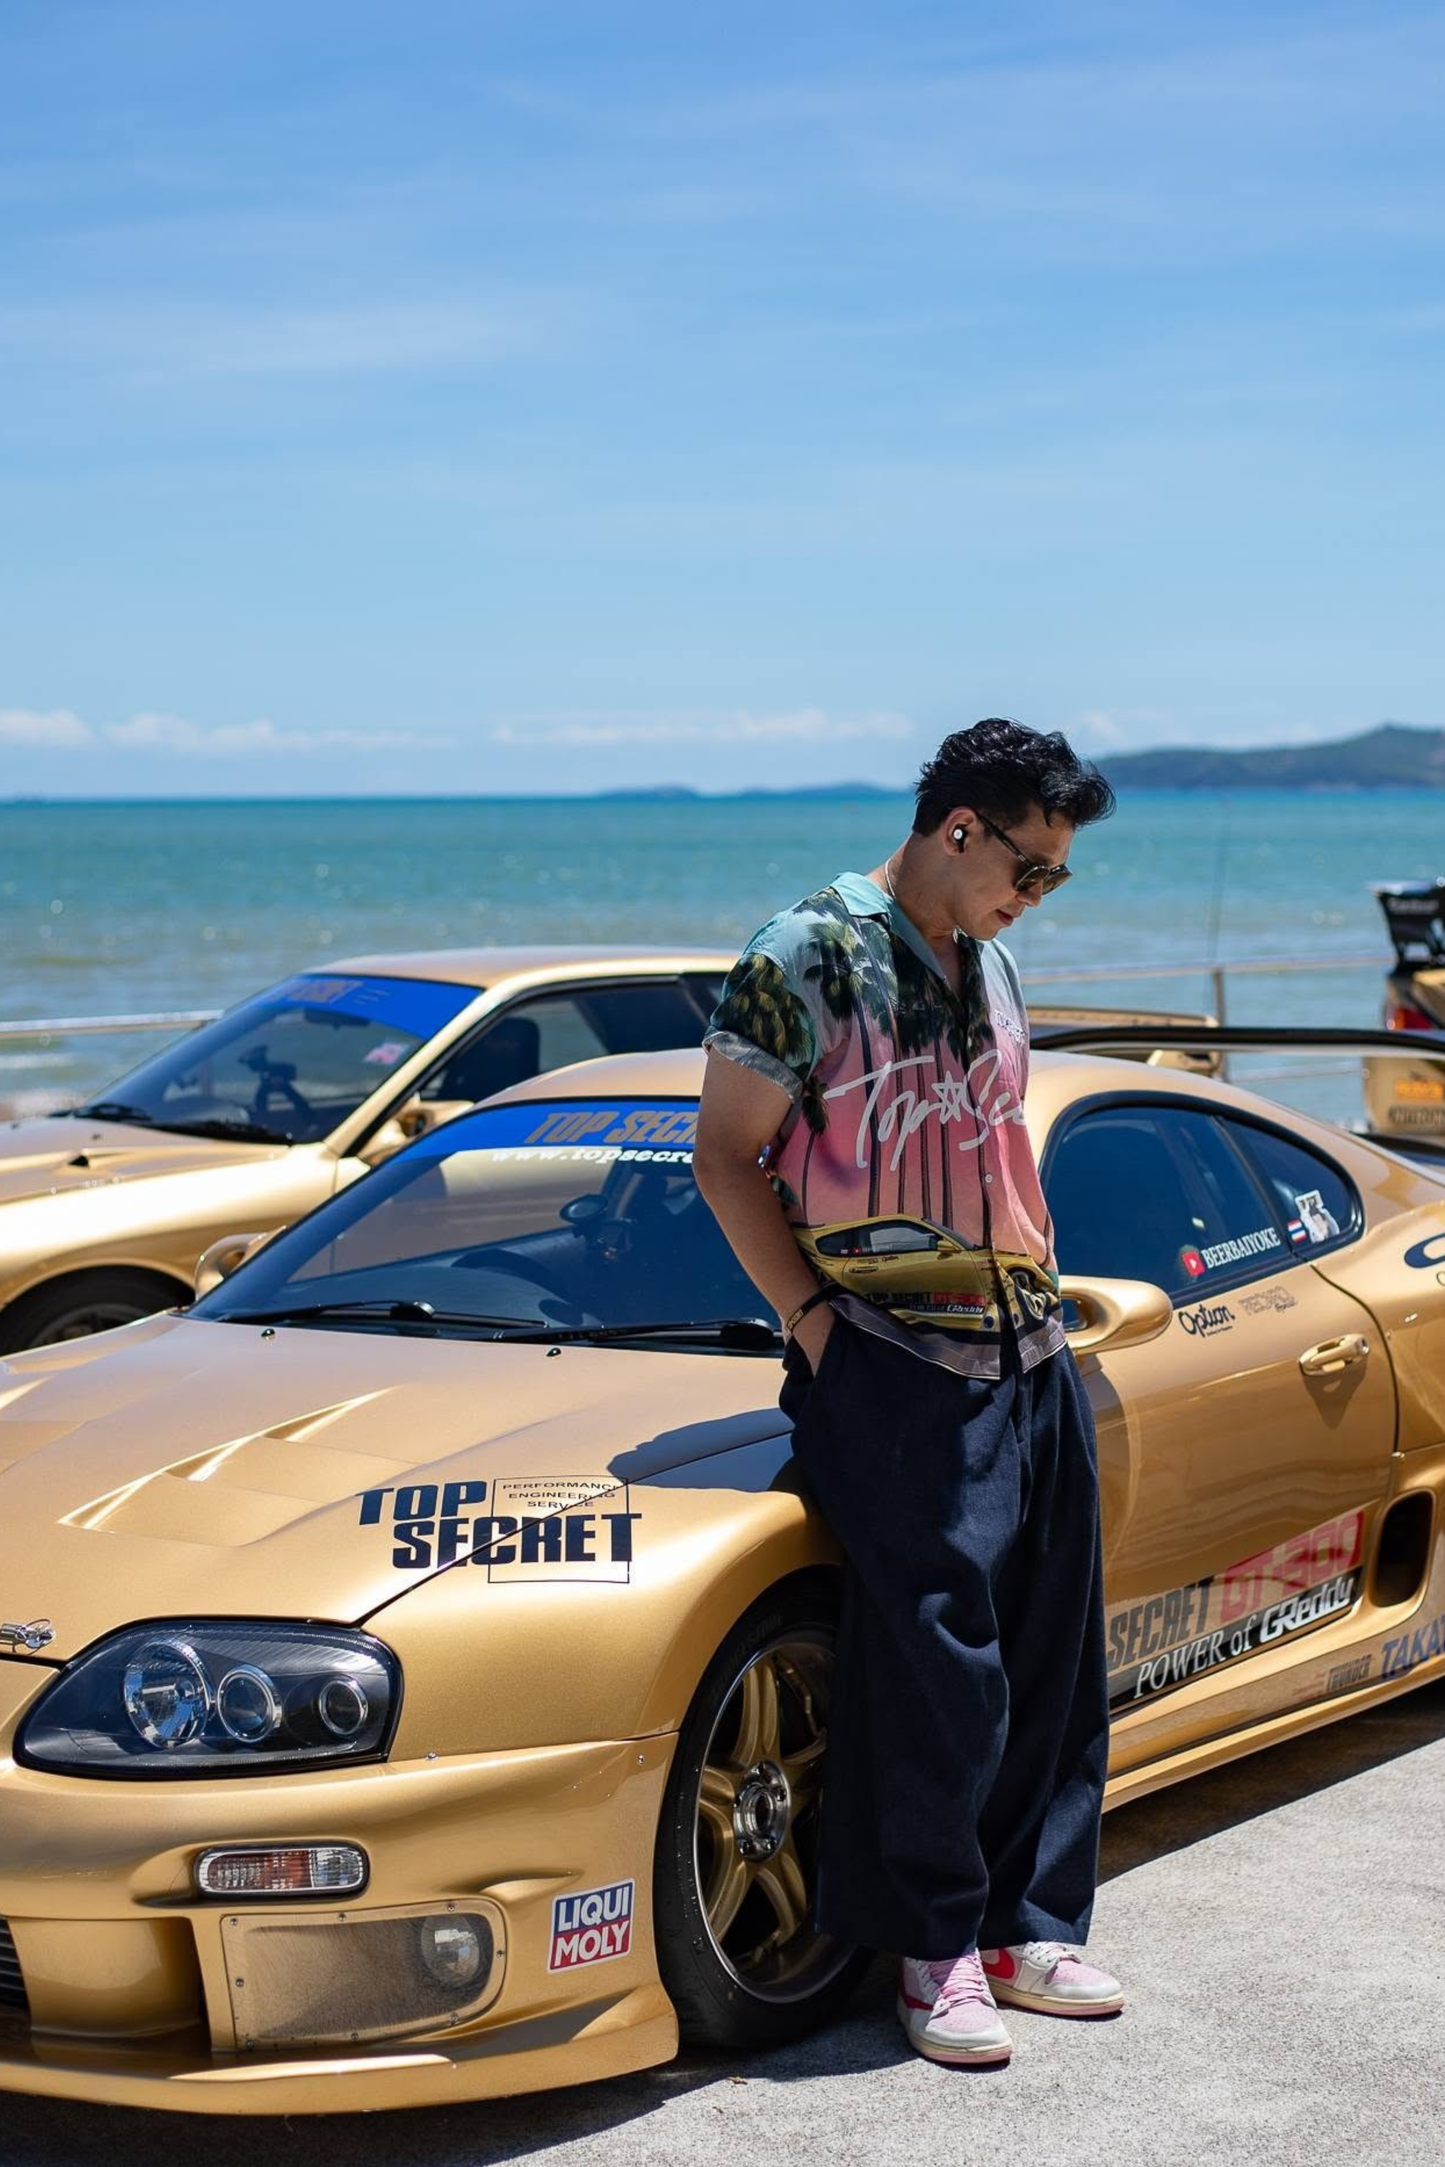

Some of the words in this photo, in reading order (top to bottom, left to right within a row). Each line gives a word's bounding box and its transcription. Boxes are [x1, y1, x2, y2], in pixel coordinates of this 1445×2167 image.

[524, 1111, 620, 1144] TOP
[1201, 1226, 1281, 1270] BEERBAIYOKE
[1178, 1304, 1236, 1338] Option
[355, 1480, 488, 1526] TOP
[508, 1491, 616, 1501] ENGINEERG
[527, 1501, 594, 1511] SERVE
[392, 1513, 642, 1569] SECRET
[1107, 1574, 1215, 1672] SECRET
[1381, 1613, 1445, 1679] TAKA
[1133, 1629, 1226, 1699] POWER
[1230, 1614, 1257, 1656] of
[557, 1885, 630, 1932] LIQUI
[554, 1920, 630, 1967] MOLY
